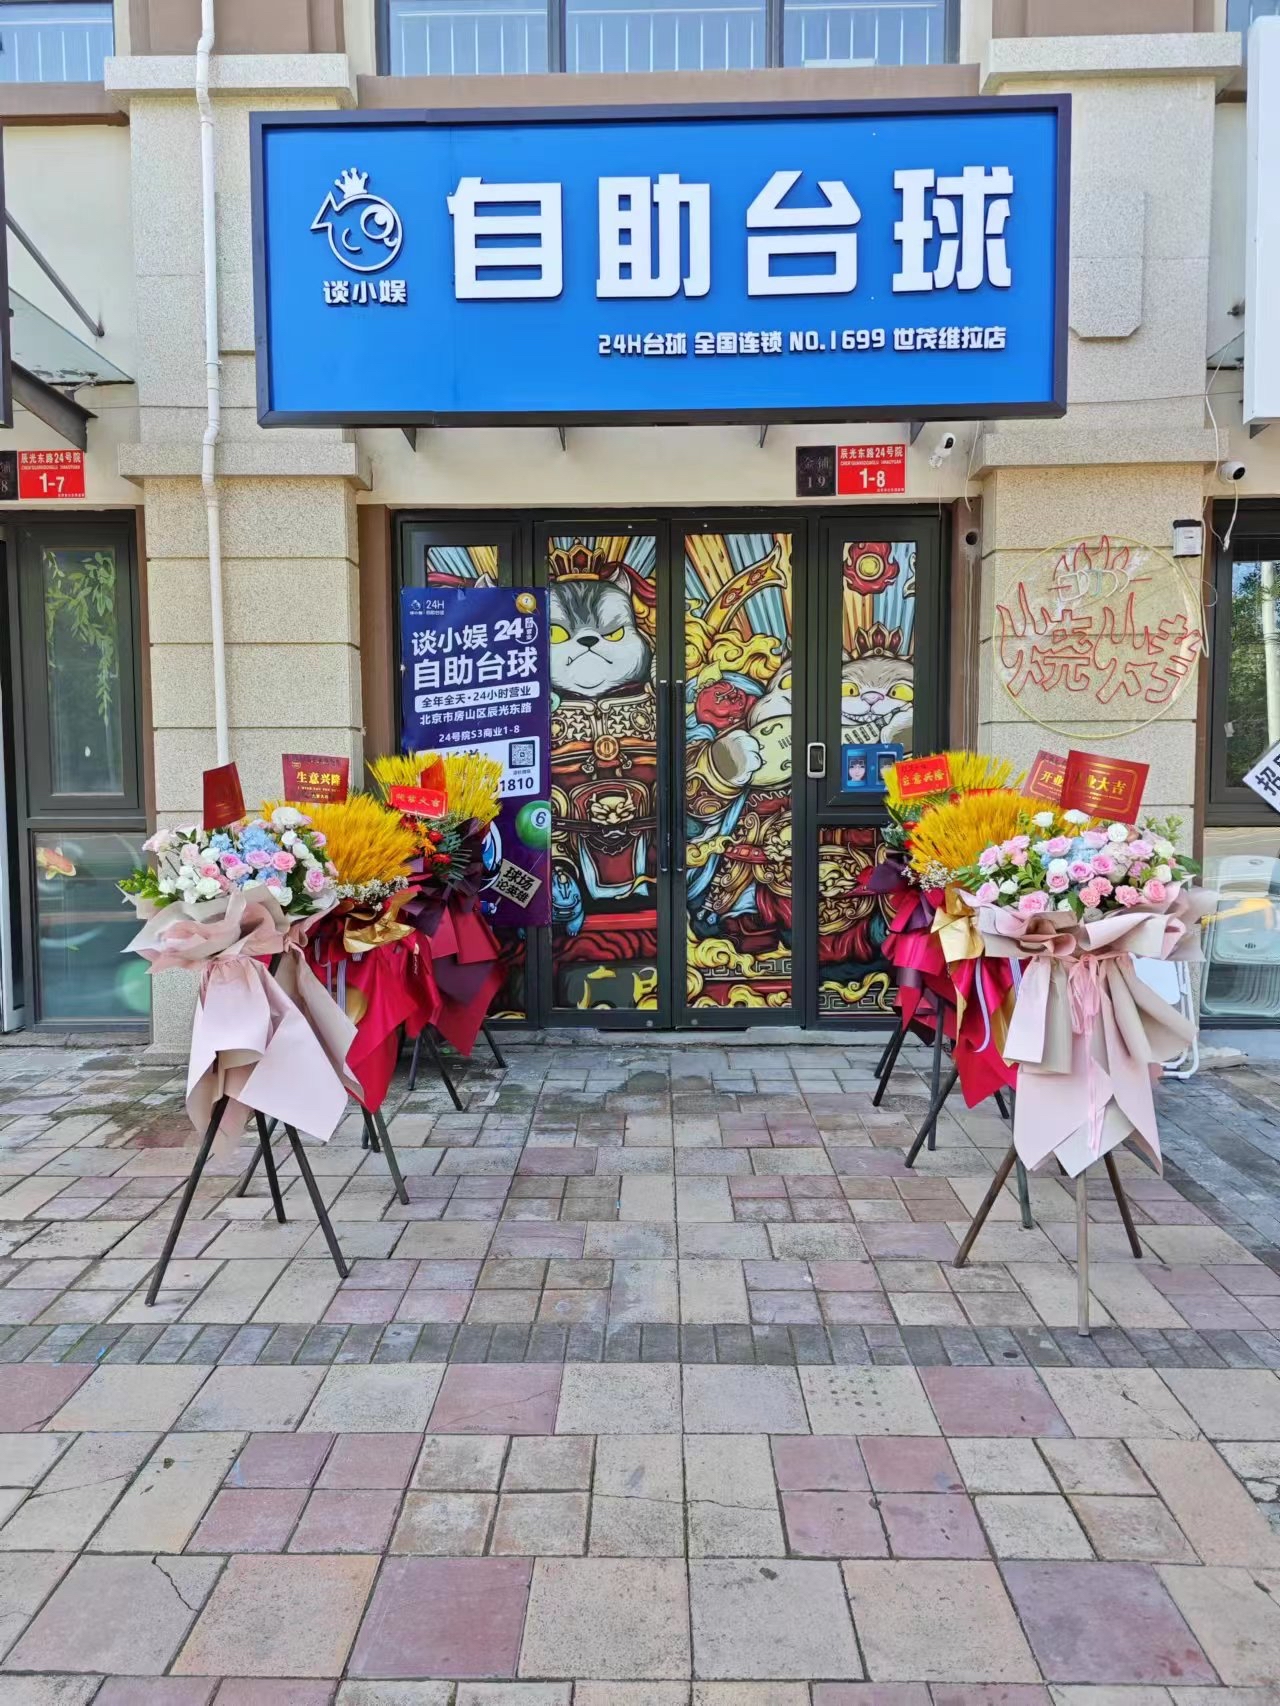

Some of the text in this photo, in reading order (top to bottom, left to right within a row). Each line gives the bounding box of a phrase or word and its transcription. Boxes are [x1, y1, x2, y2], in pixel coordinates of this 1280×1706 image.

[447, 165, 1014, 300] 自助台球
[323, 280, 407, 304] 谈小娱
[598, 326, 1007, 355] 24H台球 全国连锁 NO.1699 世茂维拉店
[21, 452, 81, 464] 辰光东路24号院
[840, 446, 903, 459] 辰光东路24号院
[39, 473, 65, 493] 1-7
[859, 468, 886, 489] 1-8
[426, 600, 445, 609] 24H
[412, 624, 489, 656] 谈小娱
[996, 582, 1200, 704] 烧烤
[414, 646, 538, 691] 自助台球
[419, 702, 532, 726] 北京市房山区辰光东路
[439, 725, 520, 743] 24号院S3商业1-8
[296, 771, 341, 786] 生意兴隆
[494, 777, 534, 794] 1810
[503, 866, 535, 891] 球场
